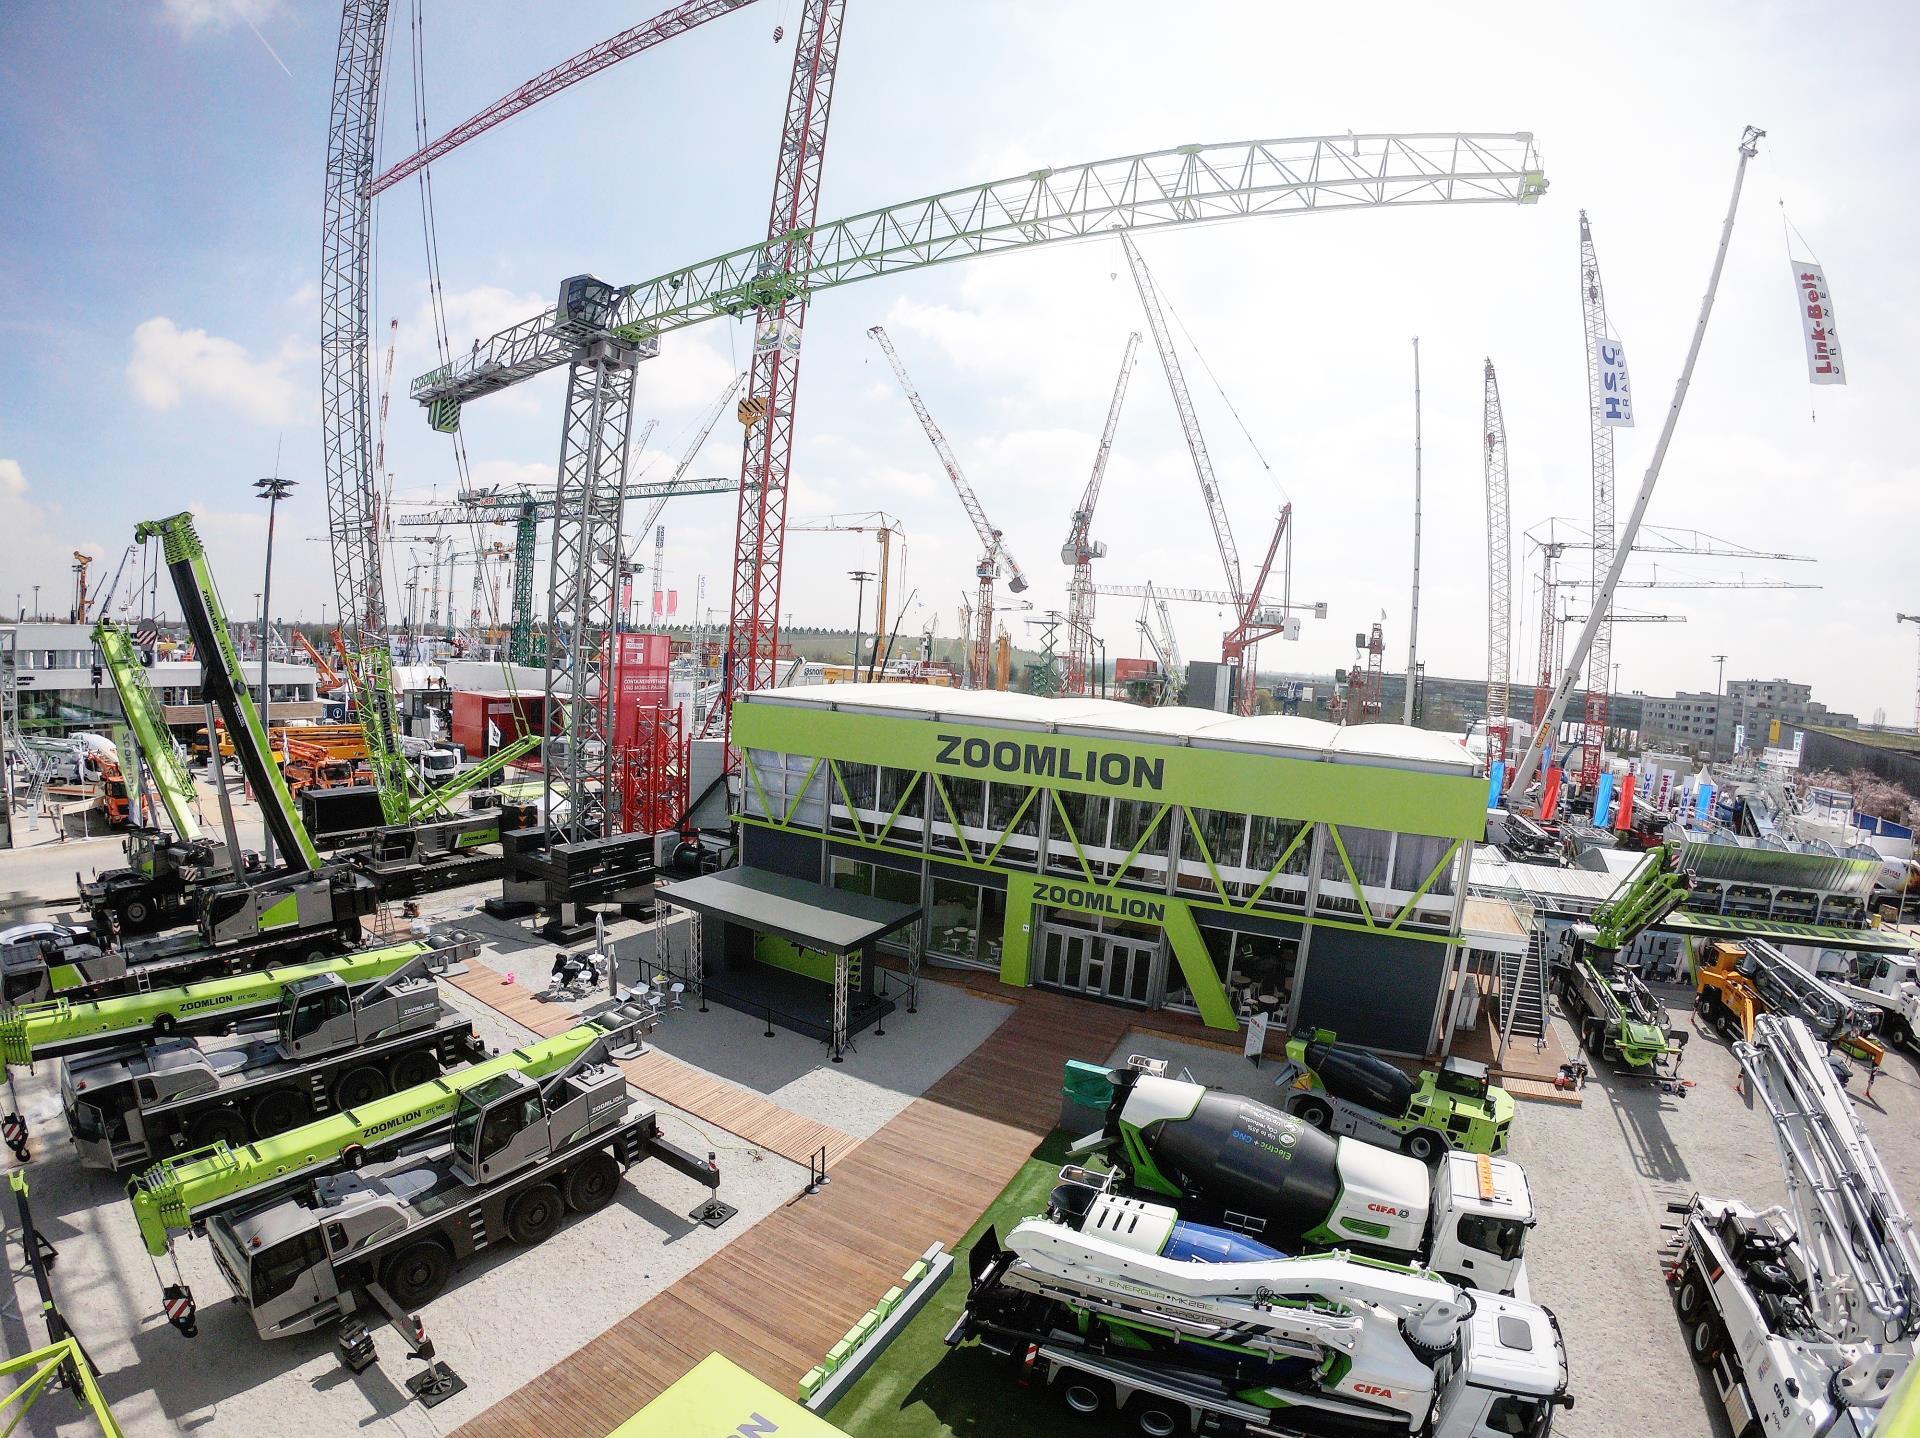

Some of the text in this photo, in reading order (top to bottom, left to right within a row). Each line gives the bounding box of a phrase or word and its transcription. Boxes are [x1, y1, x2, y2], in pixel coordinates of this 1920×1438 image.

[1800, 272, 1832, 374] Link-Belt
[1815, 275, 1840, 375] CRANES
[1602, 345, 1622, 419] HSC
[1615, 348, 1631, 420] CRANES
[202, 588, 220, 632] ZOOMLION
[378, 694, 396, 754] ZOOMLION
[936, 735, 1165, 790] ZOOMLION
[1641, 773, 1652, 800] HSC
[1678, 787, 1690, 817] HSC
[1032, 882, 1166, 922] ZOOMLION
[179, 995, 233, 1011] ZOOMLION
[404, 1002, 435, 1015] ZOOMLION
[592, 1094, 624, 1113] ZOOMLION
[363, 1109, 422, 1138] ZOOMLION
[1239, 1114, 1266, 1129] reduction
[1232, 1129, 1253, 1144] CNG
[1260, 1141, 1292, 1161] Electric
[1367, 1203, 1396, 1216] CIFA
[1353, 1383, 1392, 1399] CIFA
[1773, 1382, 1785, 1408] CIFA
